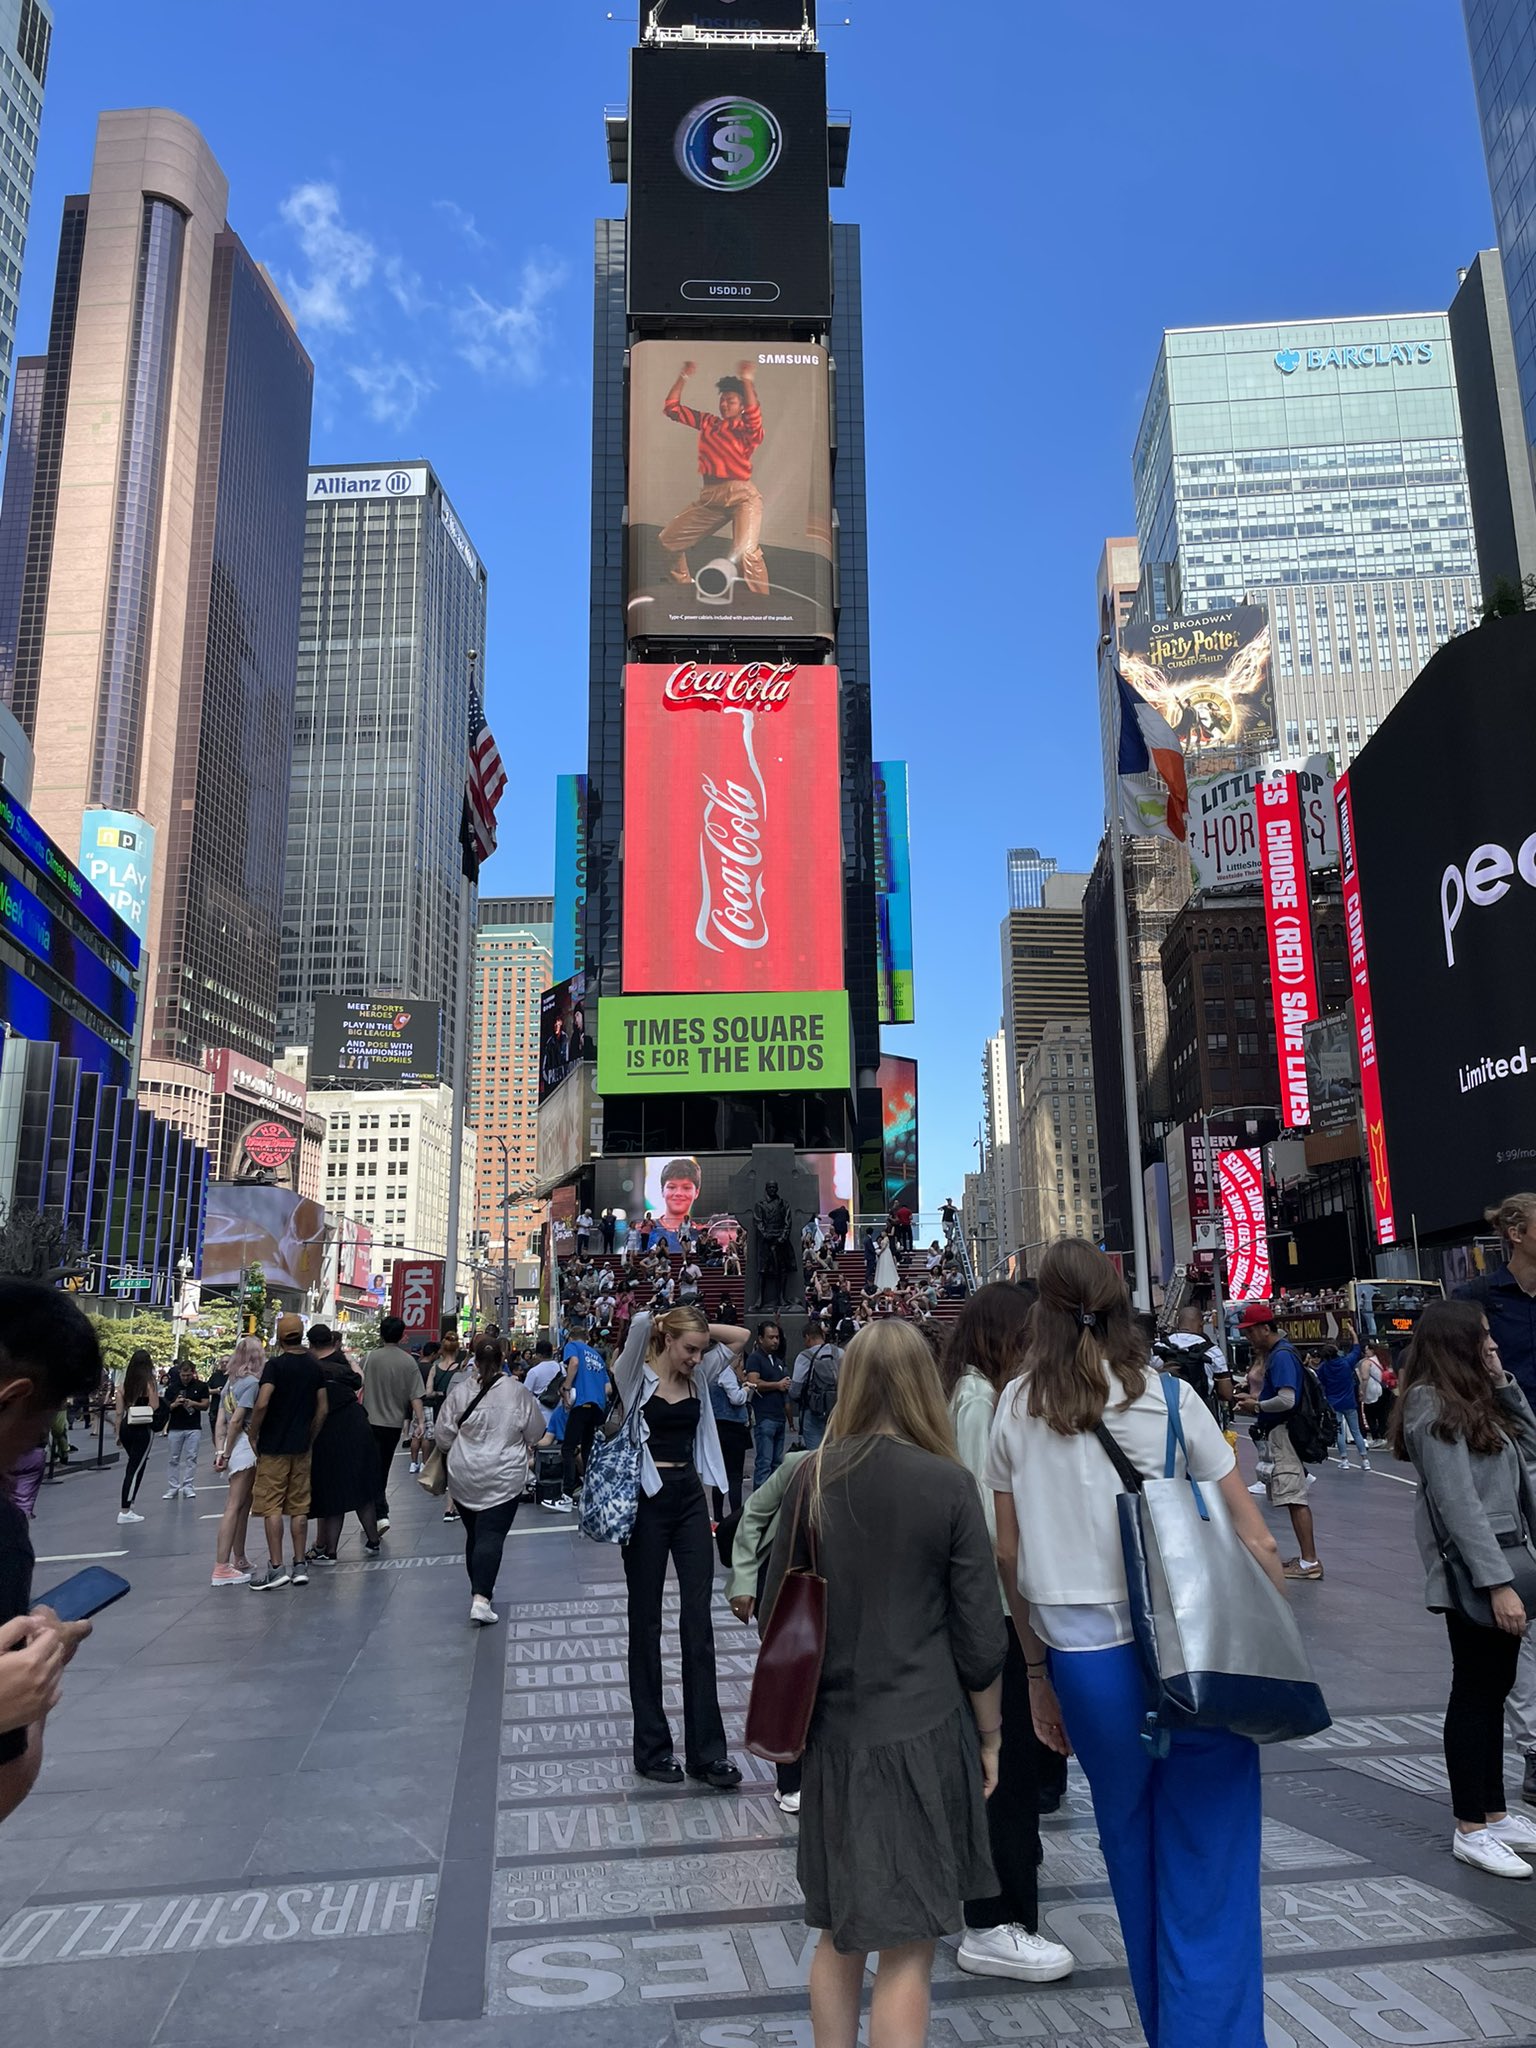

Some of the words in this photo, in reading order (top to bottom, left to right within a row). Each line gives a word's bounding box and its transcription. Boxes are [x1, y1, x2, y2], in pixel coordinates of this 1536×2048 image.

[709, 286, 751, 296] USDD.IO
[758, 354, 819, 365] SAMSUNG
[1307, 342, 1433, 369] BARCLAYS
[313, 477, 381, 495] Allianz
[1149, 637, 1192, 667] Harry
[1192, 629, 1240, 661] Potter
[1167, 659, 1197, 670] CURSED
[1198, 654, 1224, 665] CHILD
[664, 660, 798, 702] Coca-Cola
[1201, 770, 1266, 815] LITTLE
[1272, 768, 1324, 795] OP
[1203, 800, 1326, 874] HORS
[700, 773, 769, 950] Coca-Cola
[1266, 819, 1298, 910] CHOOSE
[1347, 891, 1365, 968] COME
[1273, 915, 1306, 985] (RED)
[347, 1002, 371, 1011] MEET
[371, 1004, 404, 1012] SPORTS
[359, 1010, 393, 1018] HEROES
[1281, 991, 1309, 1052] SAVE
[343, 1020, 365, 1029] PLAY
[365, 1022, 376, 1030] IN
[364, 1030, 402, 1038] LEAGUES
[623, 1016, 705, 1046] TIMES
[712, 1014, 824, 1044] SQUARE
[339, 1046, 346, 1054] 4
[347, 1047, 413, 1057] CHAMPIONSHIP
[346, 1040, 366, 1048] AND
[367, 1041, 389, 1049] POSE
[390, 1042, 413, 1050] WITH
[371, 1055, 413, 1064] TROPHIES
[626, 1049, 645, 1068] IS
[651, 1048, 690, 1068] FOR
[698, 1046, 749, 1074] THE
[758, 1043, 824, 1073] KIDS
[1286, 1056, 1311, 1126] LIVES
[260, 1125, 282, 1135] HOT
[258, 1152, 284, 1163] NOW
[1222, 1152, 1256, 1190] LIVES
[1194, 1172, 1205, 1184] A
[1228, 1192, 1247, 1221] SAVE
[1245, 1186, 1265, 1222] SAVE
[1237, 1221, 1251, 1256] (RED)
[1229, 1253, 1251, 1300] CHOOSE
[402, 1266, 434, 1328] tkts
[1304, 1319, 1321, 1339] YORK
[517, 1600, 599, 1614] WILSON
[510, 1758, 634, 1780] INSON
[510, 1774, 637, 1797] OOKS
[510, 1797, 798, 1851] MPERIAL
[507, 1865, 606, 1884] GOLDEN
[507, 1879, 604, 1894] JOHN
[506, 1880, 806, 1922] MAJESTIC
[1262, 1879, 1441, 1916] HAY
[0, 1878, 424, 1963] HIRSCHFELD
[1262, 1904, 1493, 1950] HELE
[1262, 1957, 1536, 2048] YRI
